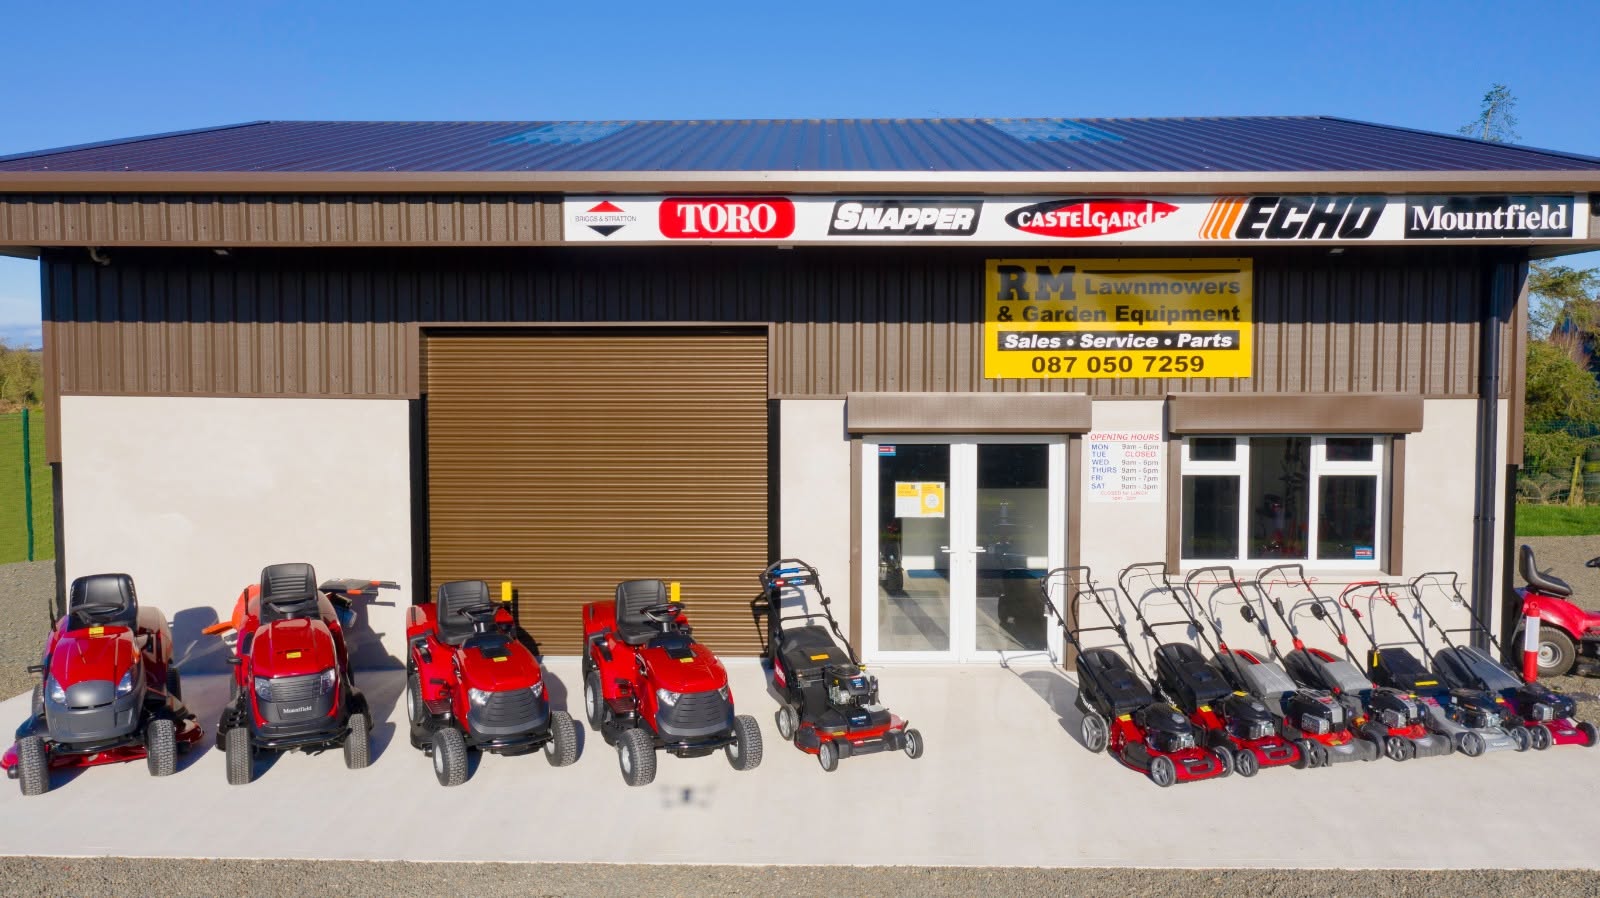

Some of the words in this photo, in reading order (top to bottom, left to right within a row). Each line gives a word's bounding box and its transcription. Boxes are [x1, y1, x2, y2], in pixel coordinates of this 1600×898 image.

[676, 203, 778, 233] TORO
[835, 202, 973, 231] SNAPPER
[1235, 196, 1389, 240] ECHO
[1411, 204, 1568, 233] Mountfield
[997, 265, 1077, 300] RM
[1085, 278, 1241, 295] Lawnmowers
[997, 305, 1013, 322] &
[1022, 305, 1107, 322] Garden
[1115, 305, 1241, 325] Equipment
[1004, 334, 1061, 349] Sales
[1080, 334, 1159, 349] Service
[1177, 333, 1232, 348] Parts
[1031, 356, 1077, 373] 087
[1087, 355, 1133, 373] 050
[1142, 355, 1205, 372] 7259
[1090, 433, 1128, 441] OPENING
[1130, 433, 1160, 441] HOURS
